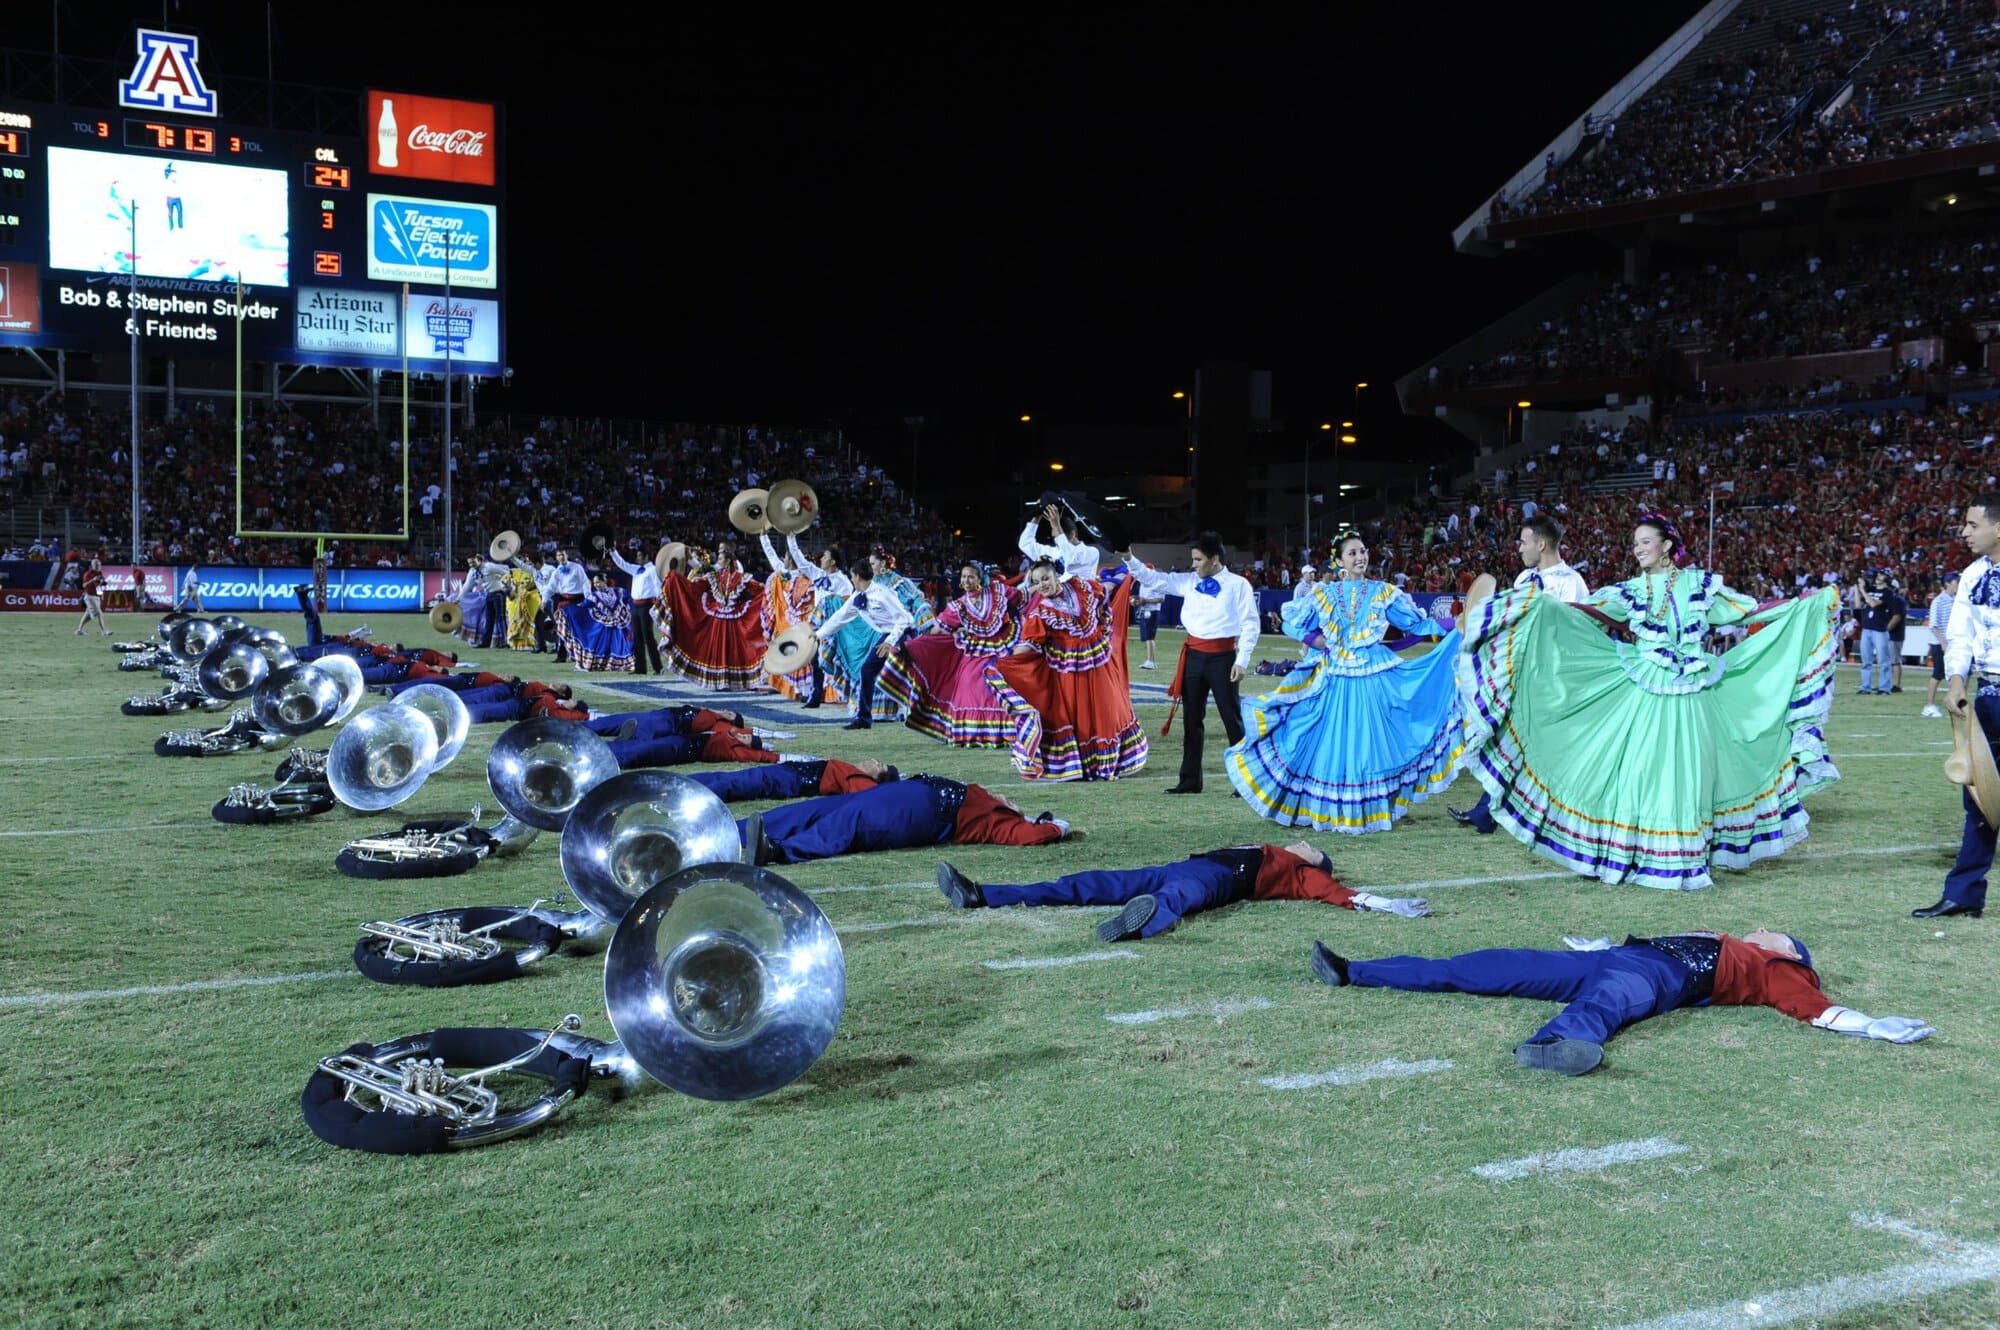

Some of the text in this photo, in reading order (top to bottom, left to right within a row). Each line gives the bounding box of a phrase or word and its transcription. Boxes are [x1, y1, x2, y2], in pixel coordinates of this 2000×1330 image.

[118, 28, 218, 118] A
[72, 122, 94, 134] TOL
[97, 122, 109, 138] 3
[145, 123, 213, 153] 7:13
[230, 137, 241, 152] 3
[243, 141, 263, 153] TOL
[408, 124, 487, 156] Coca-Cola
[315, 147, 338, 162] CAL
[2, 167, 25, 179] TO GO
[314, 166, 348, 188] 24
[321, 199, 335, 210] QTR
[322, 212, 333, 229] 3
[403, 209, 463, 230] Tucson
[409, 227, 479, 247] Electric
[416, 242, 478, 262] Power
[316, 253, 339, 274] 25
[59, 286, 279, 321] Bob & Stephen Snyder
[309, 291, 384, 314] Arizona
[124, 318, 218, 341] & Friends
[297, 311, 395, 336] Daily Star
[327, 338, 363, 349] Tucson
[105, 574, 163, 584] ALL AESS
[122, 584, 167, 593] DEAND
[5, 594, 26, 606] Go
